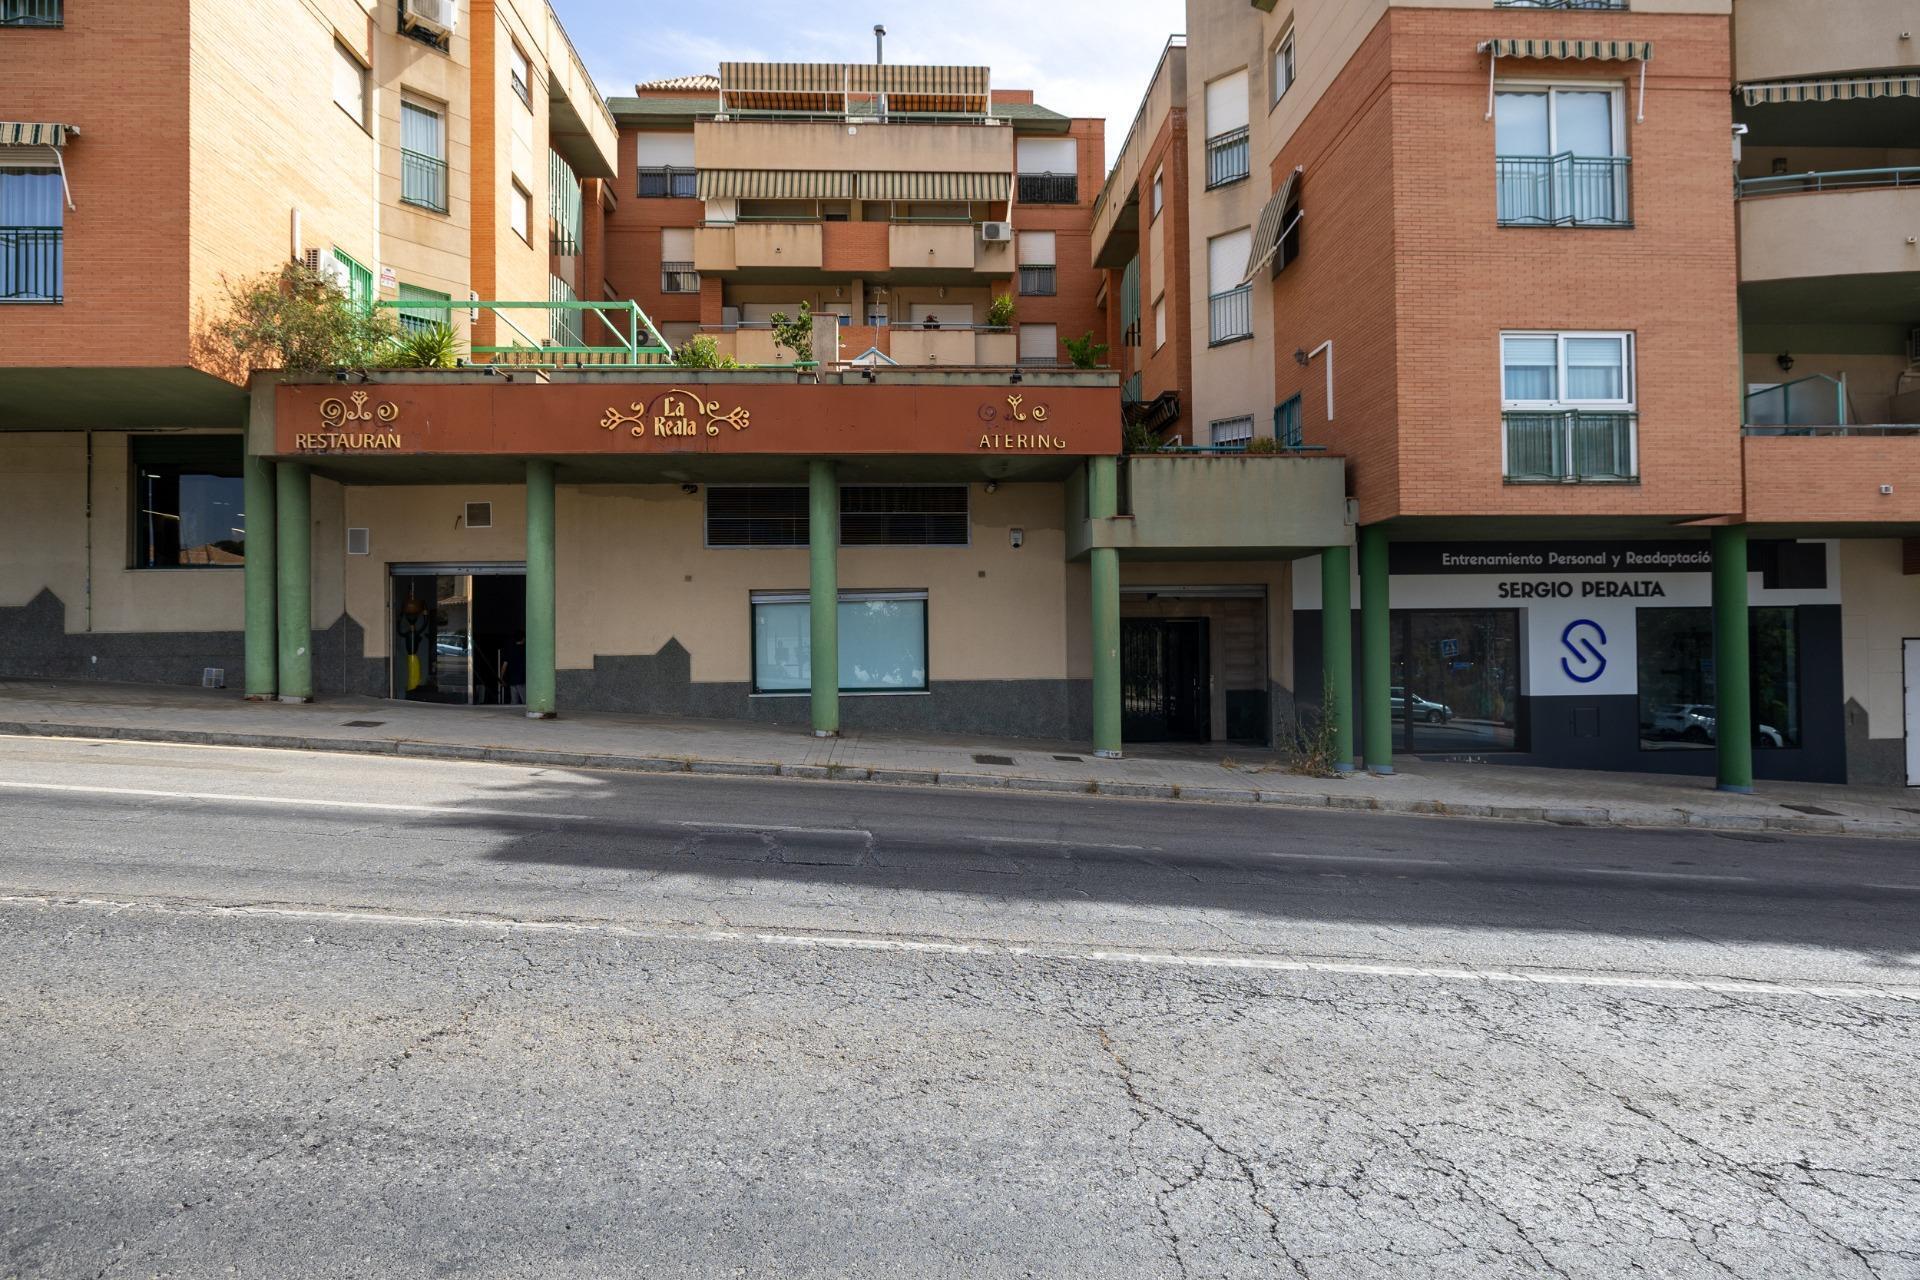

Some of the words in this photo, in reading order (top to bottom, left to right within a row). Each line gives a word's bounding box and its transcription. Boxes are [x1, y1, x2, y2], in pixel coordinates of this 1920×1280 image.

[664, 397, 685, 417] La
[654, 416, 697, 438] Reala
[295, 433, 401, 449] RESTAURAN
[979, 434, 1066, 449] ATERING
[1442, 552, 1543, 566] Entrenamiento
[1548, 552, 1606, 565] Personal
[1611, 555, 1621, 568] y
[1626, 551, 1713, 567] Readaptació
[1498, 581, 1573, 598] SERGIO
[1582, 580, 1666, 597] PERALTA
